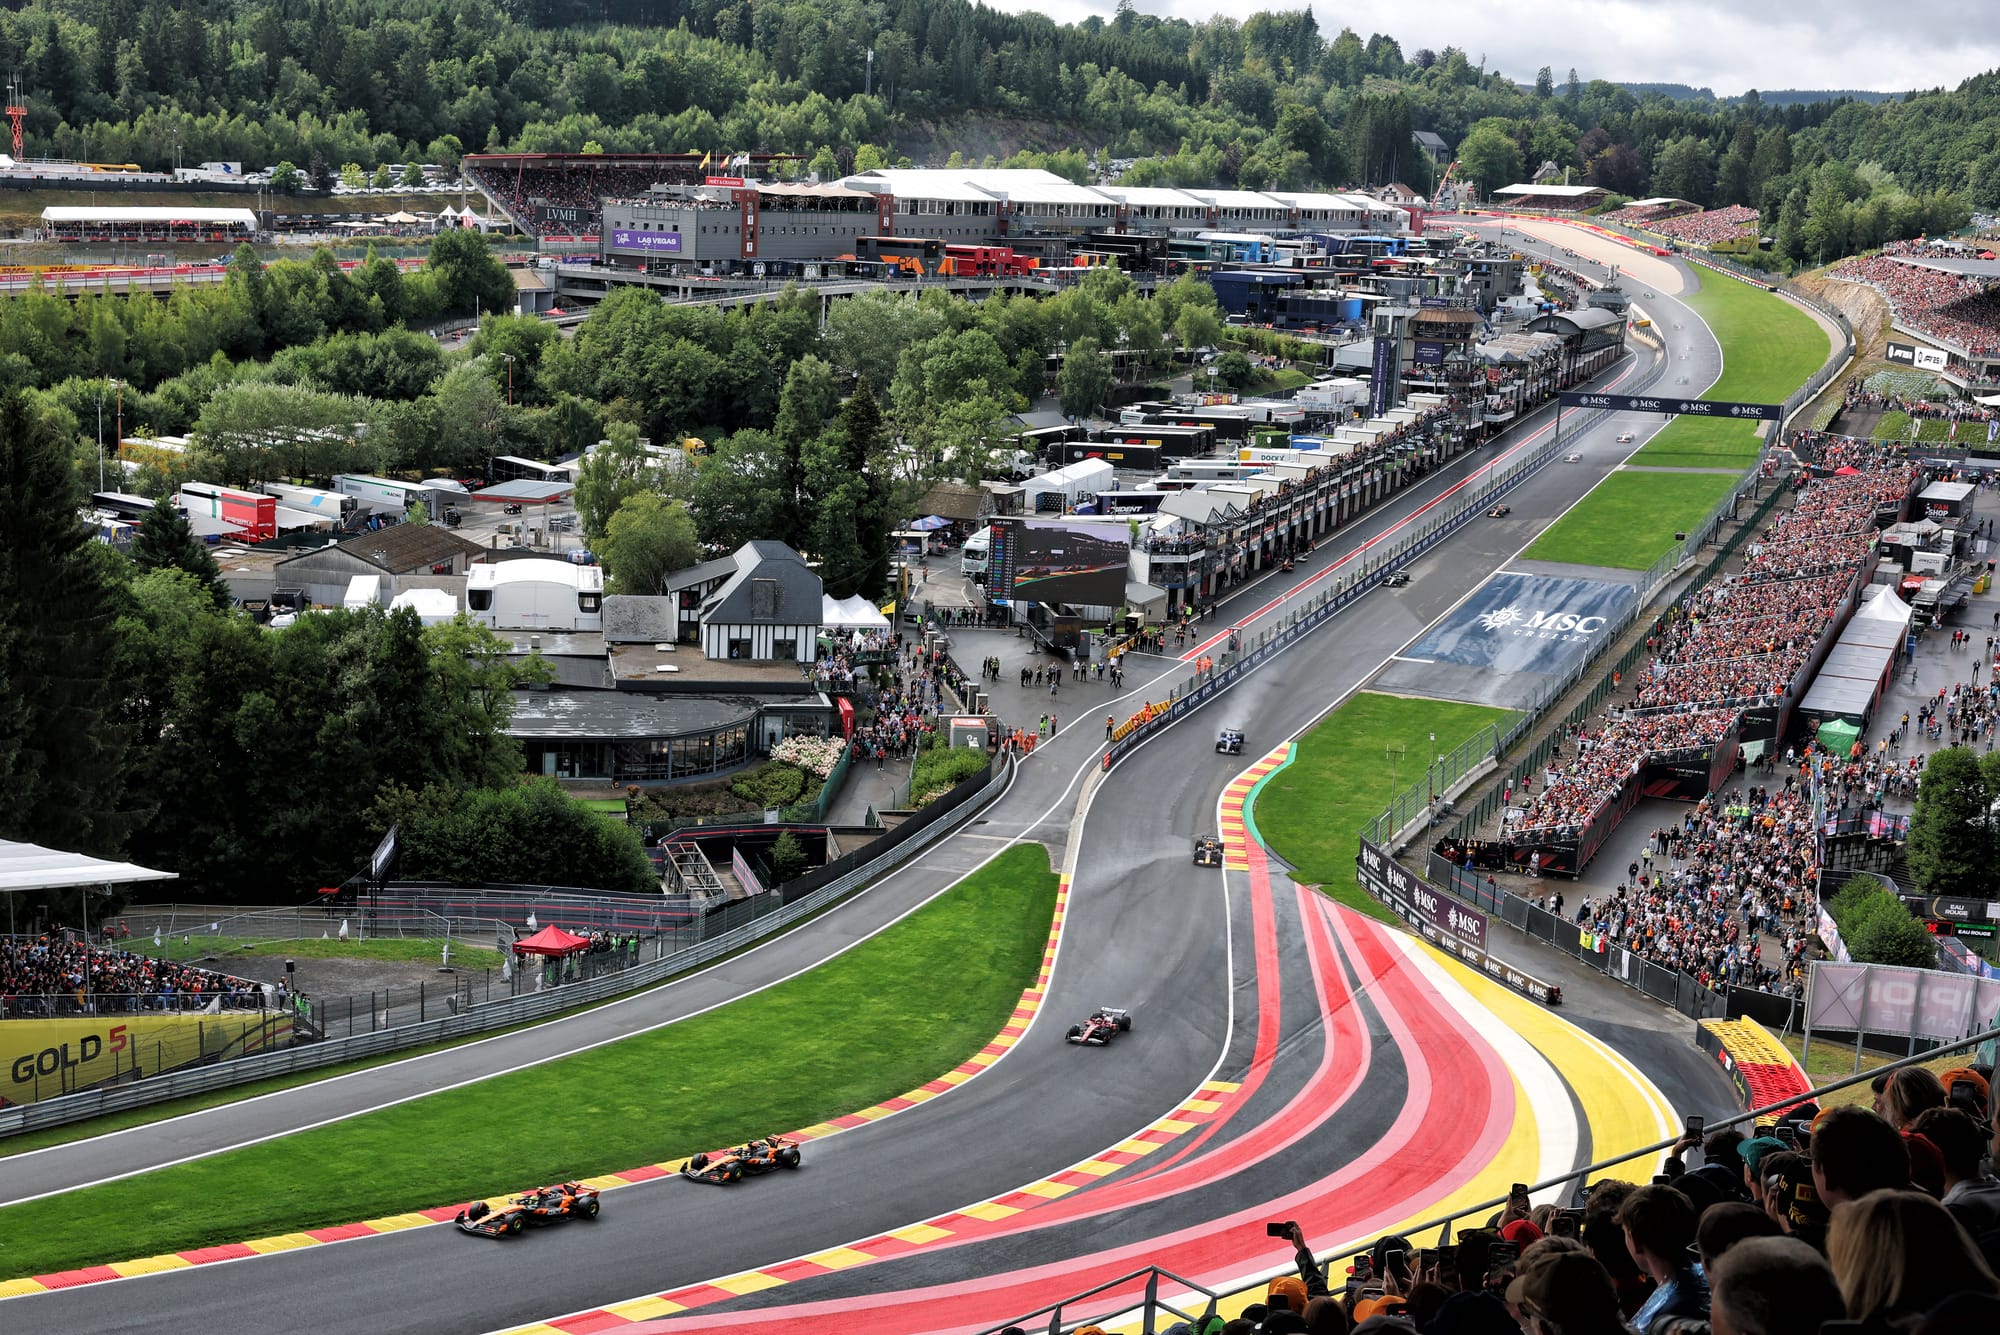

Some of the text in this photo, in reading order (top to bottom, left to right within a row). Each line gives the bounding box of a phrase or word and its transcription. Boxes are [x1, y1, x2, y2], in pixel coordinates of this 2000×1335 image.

[546, 208, 578, 221] LVMH
[1590, 396, 1610, 405] MSC
[1640, 400, 1660, 408] MSC
[1690, 403, 1711, 412] MSC
[1741, 406, 1762, 415] MSC
[1521, 610, 1607, 633] MSC
[1513, 630, 1590, 642] CRUISES
[1368, 850, 1380, 871] MSC
[1393, 870, 1407, 891] MSC
[1420, 890, 1437, 913] MSC
[1459, 912, 1480, 936] MSC
[1446, 938, 1456, 950] MSC
[1467, 950, 1478, 961] MSC
[1490, 962, 1501, 974] MSC
[1512, 973, 1524, 986] MSC
[1534, 985, 1547, 998] MSC
[12, 1024, 127, 1083] GOLD 5
